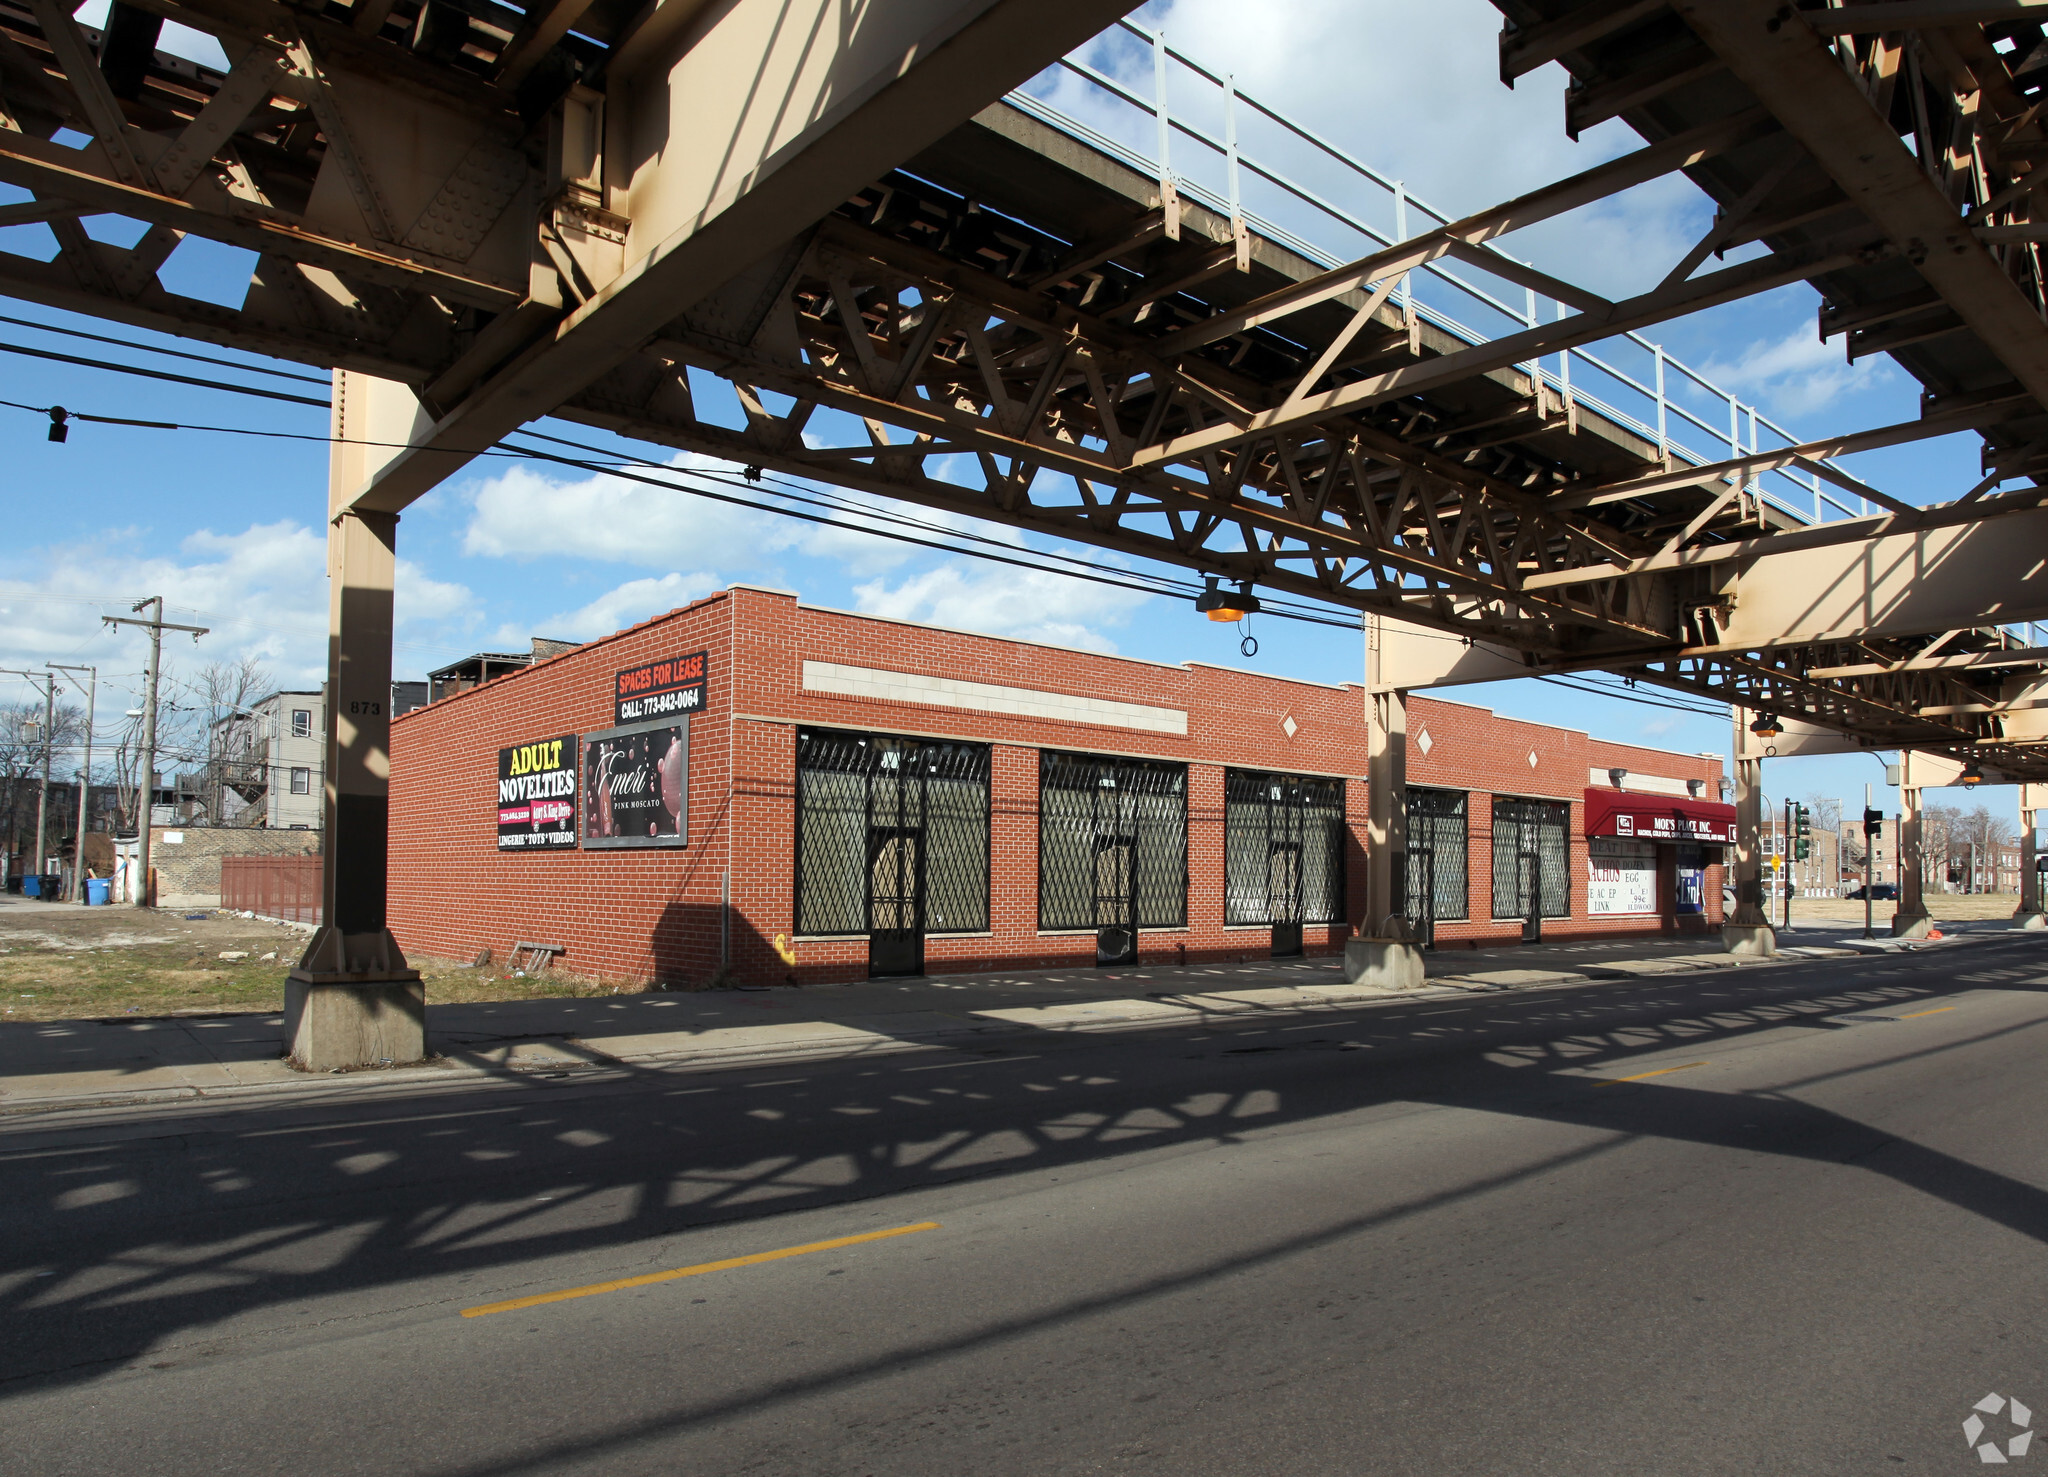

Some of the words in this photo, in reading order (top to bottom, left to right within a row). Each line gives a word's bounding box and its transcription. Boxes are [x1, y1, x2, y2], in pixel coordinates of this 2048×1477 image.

[619, 668, 651, 695] SPACES
[652, 664, 671, 687] FOR
[673, 655, 704, 682] LEASE
[350, 701, 380, 715] 873
[621, 700, 643, 719] CALL:
[643, 688, 699, 716] 773-842-0064
[509, 740, 563, 776] ADULT
[498, 769, 575, 804] NOVELTIES
[614, 801, 629, 810] PINK
[630, 799, 660, 809] MOSCATO
[1654, 817, 1676, 831] MOE'S
[1677, 819, 1697, 832] PLACE
[1698, 821, 1712, 833] INC.
[548, 831, 575, 844] VIDEOS
[1594, 901, 1610, 912] LINK
